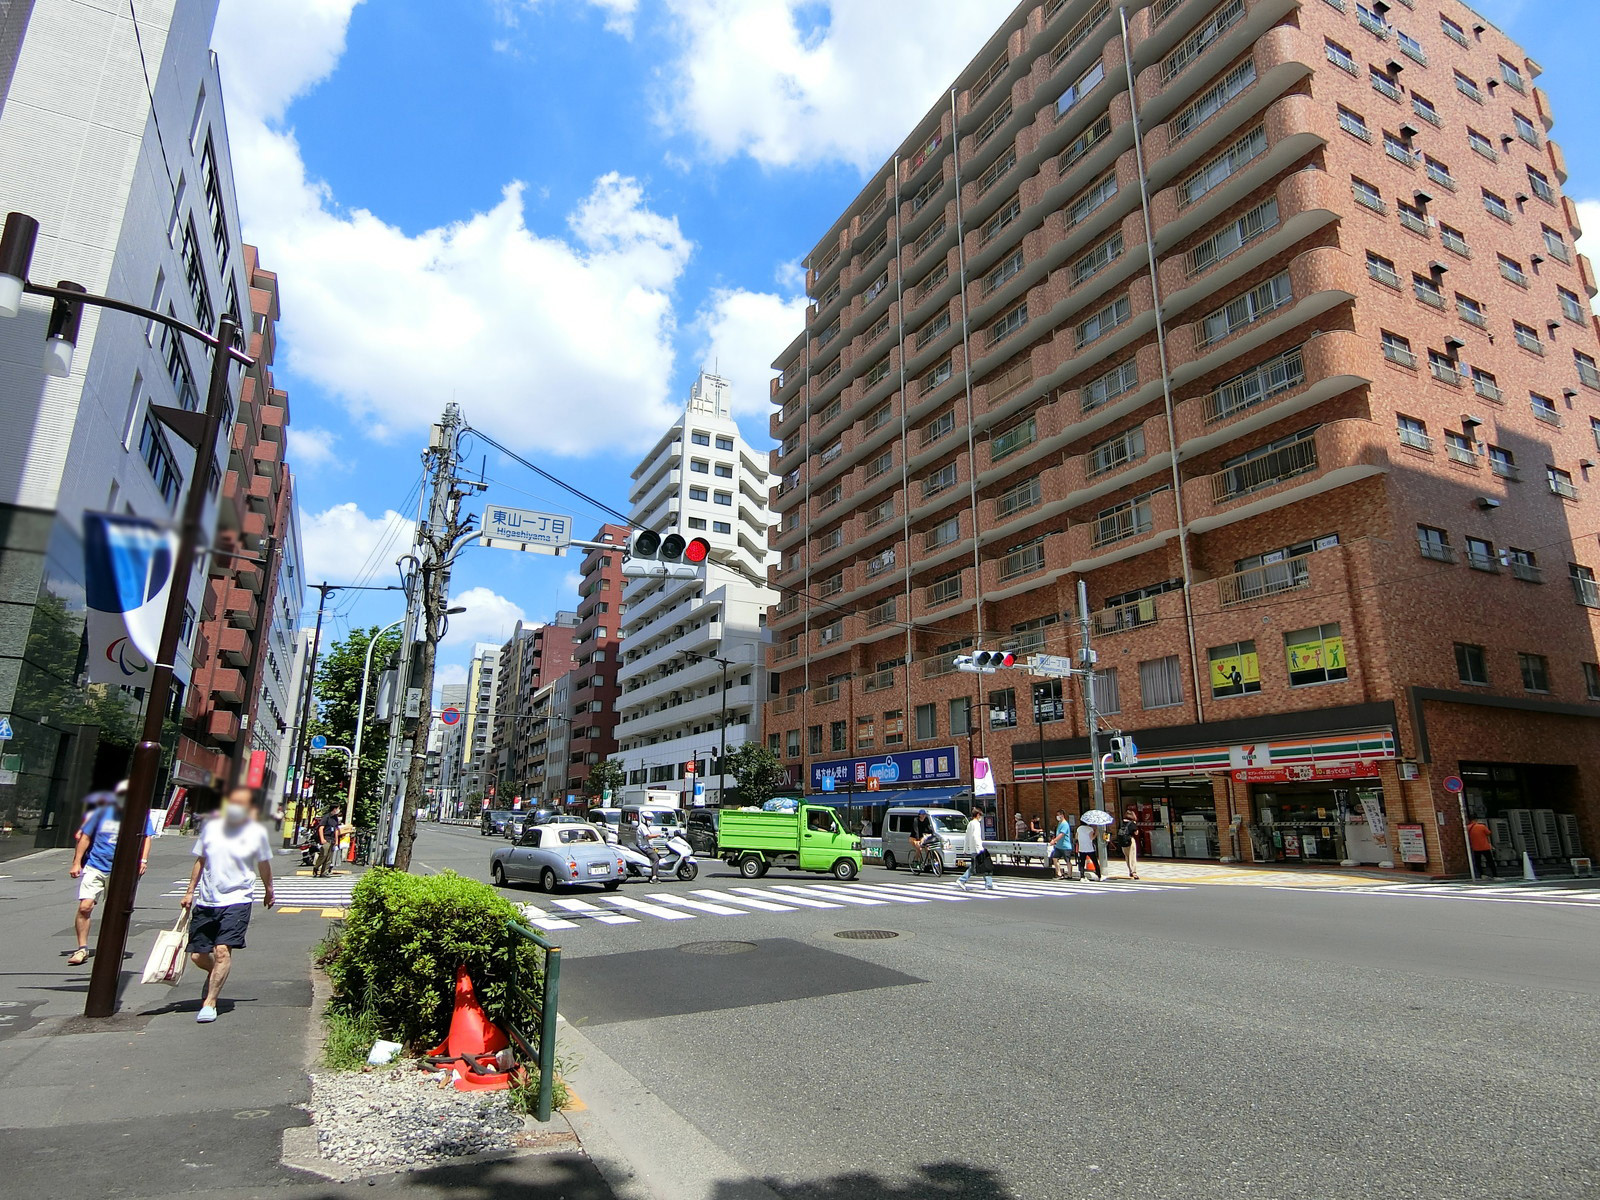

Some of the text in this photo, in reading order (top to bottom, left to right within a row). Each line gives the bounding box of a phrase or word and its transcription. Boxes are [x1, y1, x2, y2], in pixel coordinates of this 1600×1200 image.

[492, 510, 565, 534] 東山一丁目
[496, 527, 559, 543] Higashiyama 1
[815, 765, 848, 780] 処方せん受付
[871, 768, 896, 780] welcia
